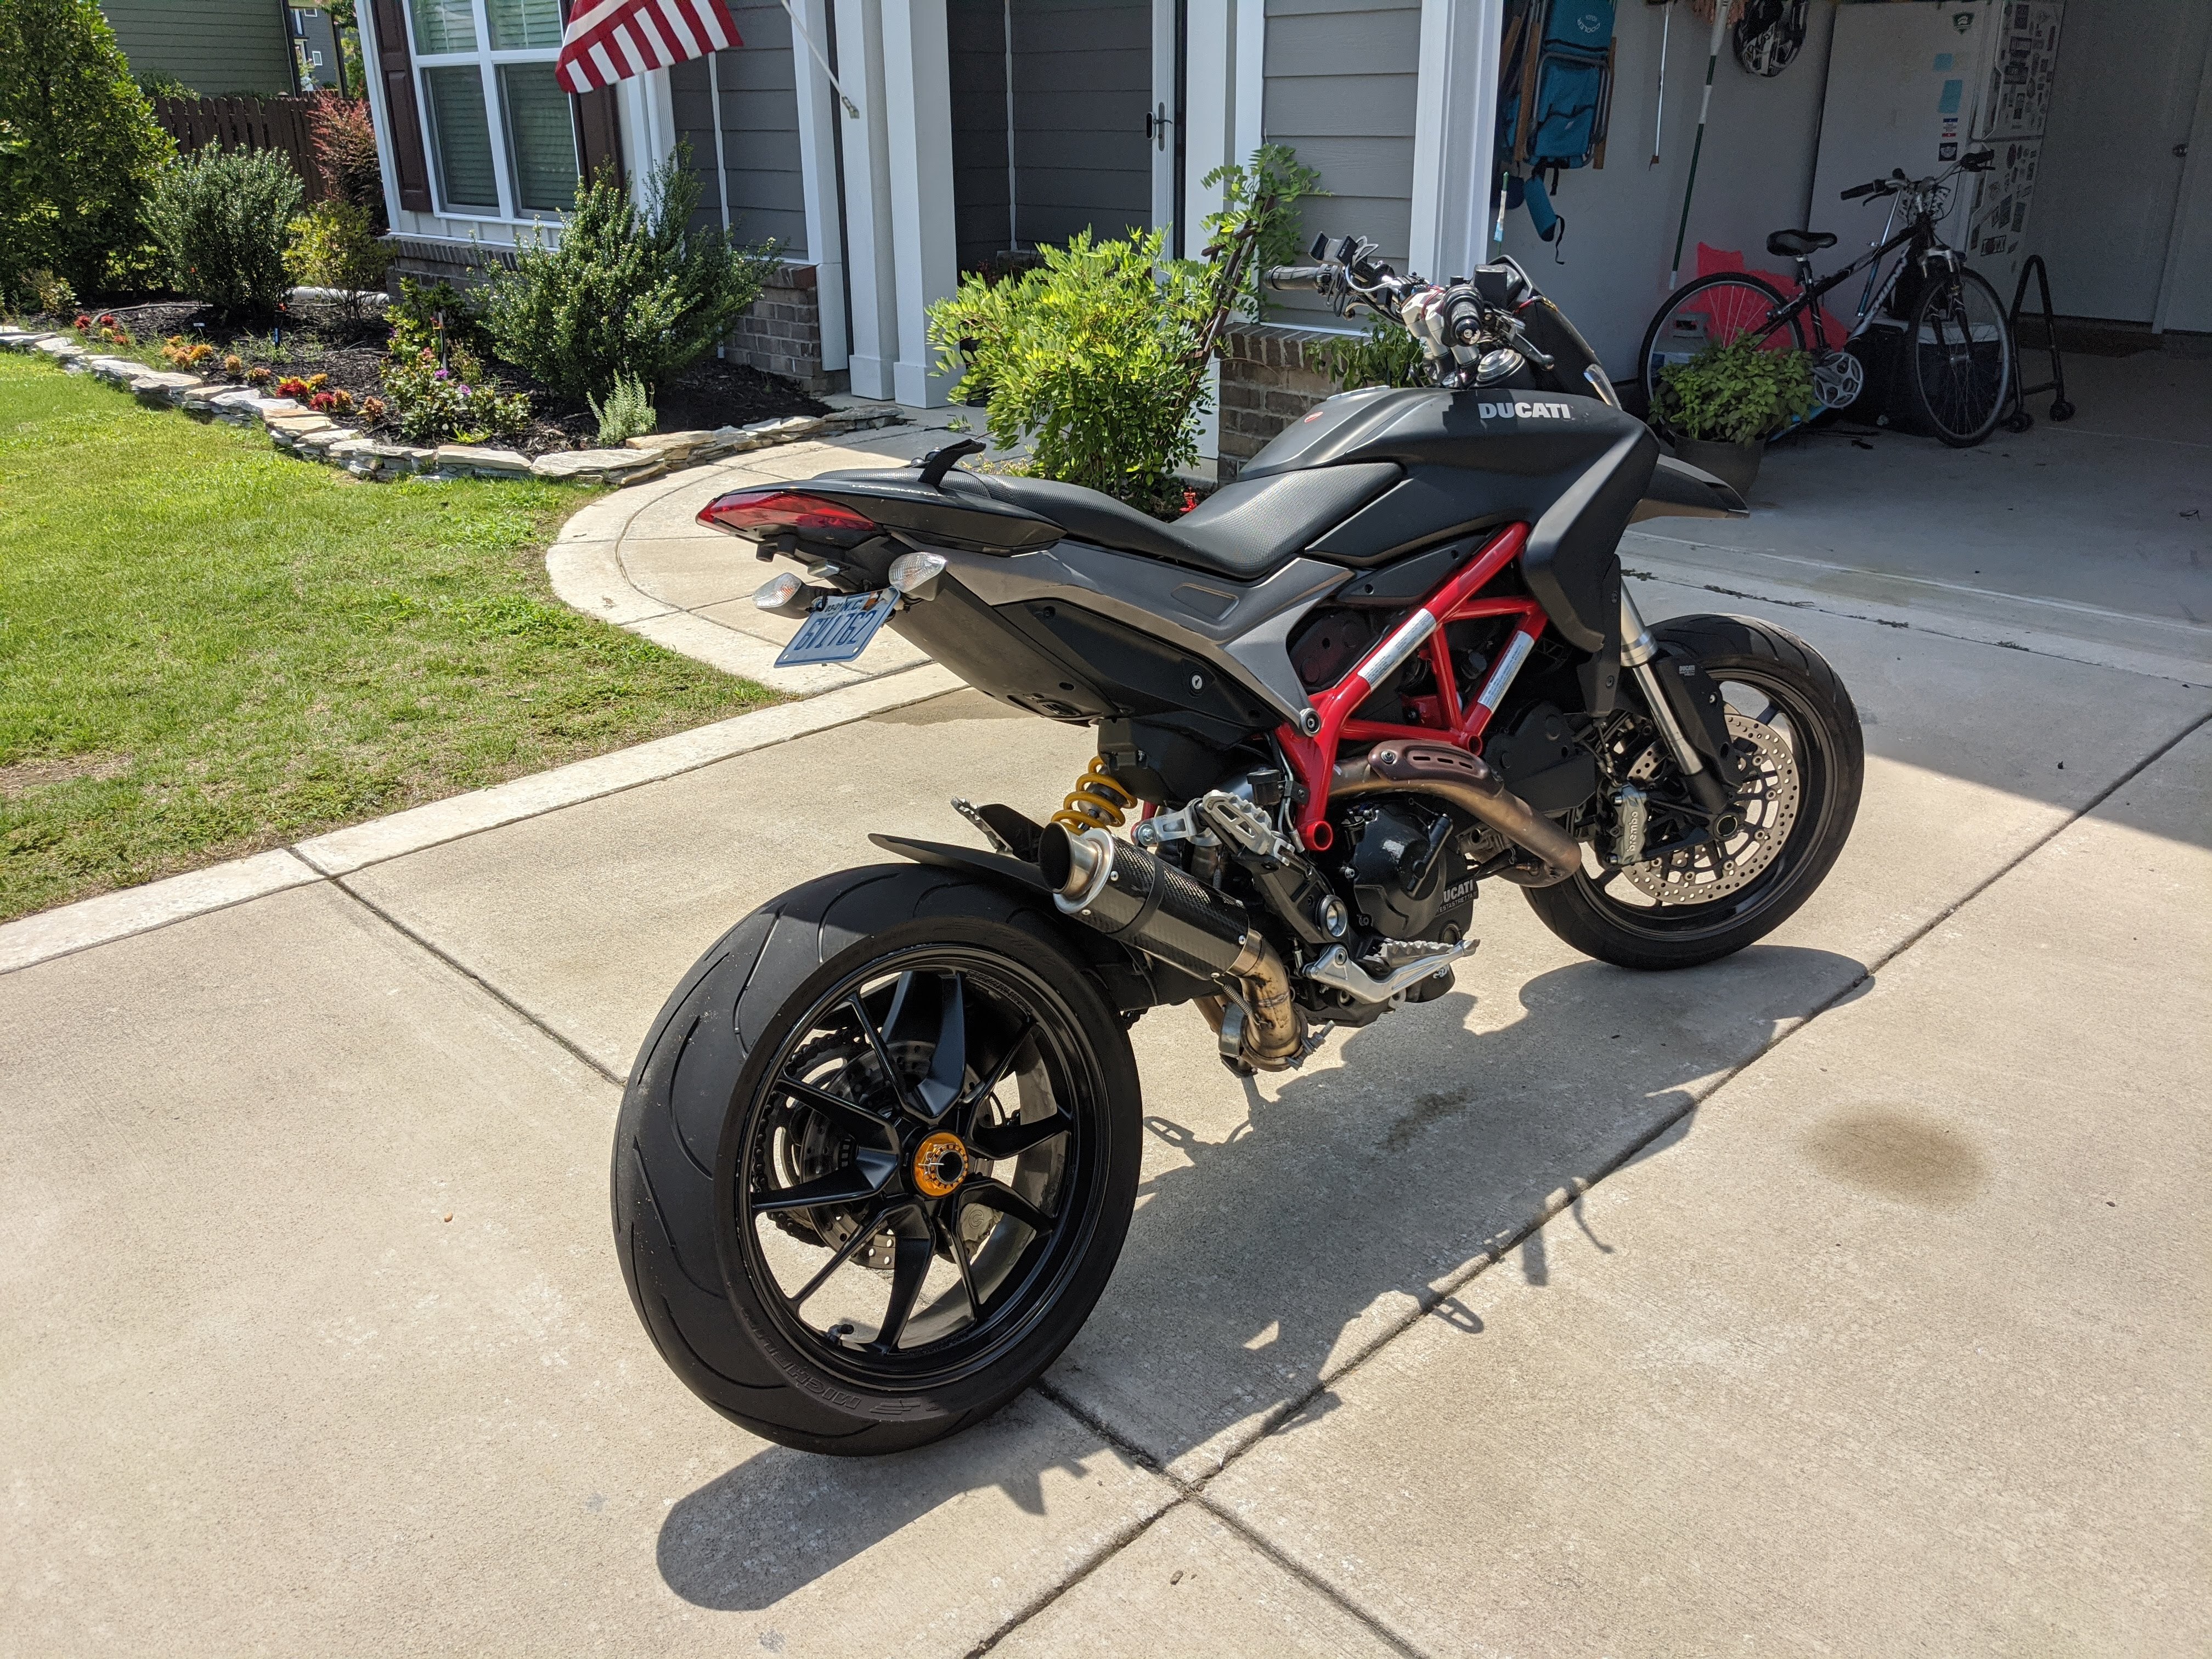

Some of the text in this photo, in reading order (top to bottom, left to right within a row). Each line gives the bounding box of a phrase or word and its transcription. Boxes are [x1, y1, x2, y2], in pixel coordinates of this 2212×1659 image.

[1577, 17, 1600, 33] COOLER
[1478, 402, 1571, 419] DUCATI
[852, 484, 956, 499] HYPERMOTARD
[1626, 810, 1638, 852] brembo
[1443, 879, 1473, 903] UCATI
[741, 1307, 862, 1410] MICHELIN
